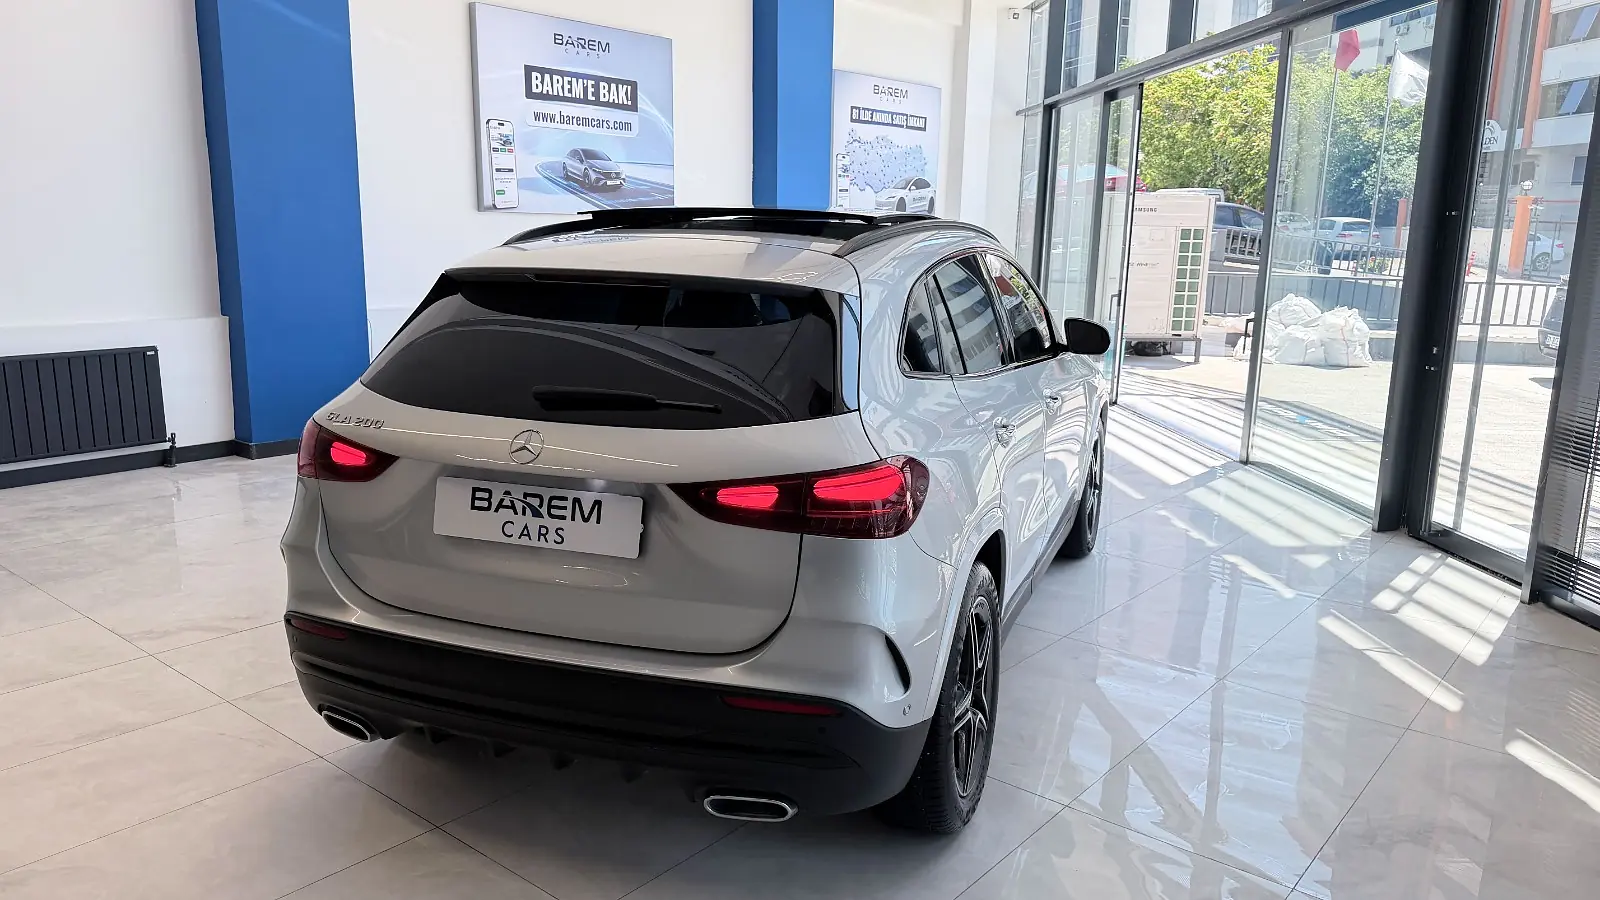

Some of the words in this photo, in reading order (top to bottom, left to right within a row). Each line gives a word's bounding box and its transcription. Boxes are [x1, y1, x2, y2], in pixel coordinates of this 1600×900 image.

[553, 32, 610, 53] BAREM
[564, 48, 600, 59] CARS
[531, 71, 596, 101] BAREM'E
[599, 81, 632, 106] BAK!
[873, 84, 908, 99] BAREM
[533, 110, 632, 132] www.baremcars.com
[1482, 135, 1498, 145] DEN
[325, 411, 352, 425] GLA
[352, 416, 385, 430] 200
[470, 486, 603, 525] BAREM
[501, 520, 565, 545] CARS
